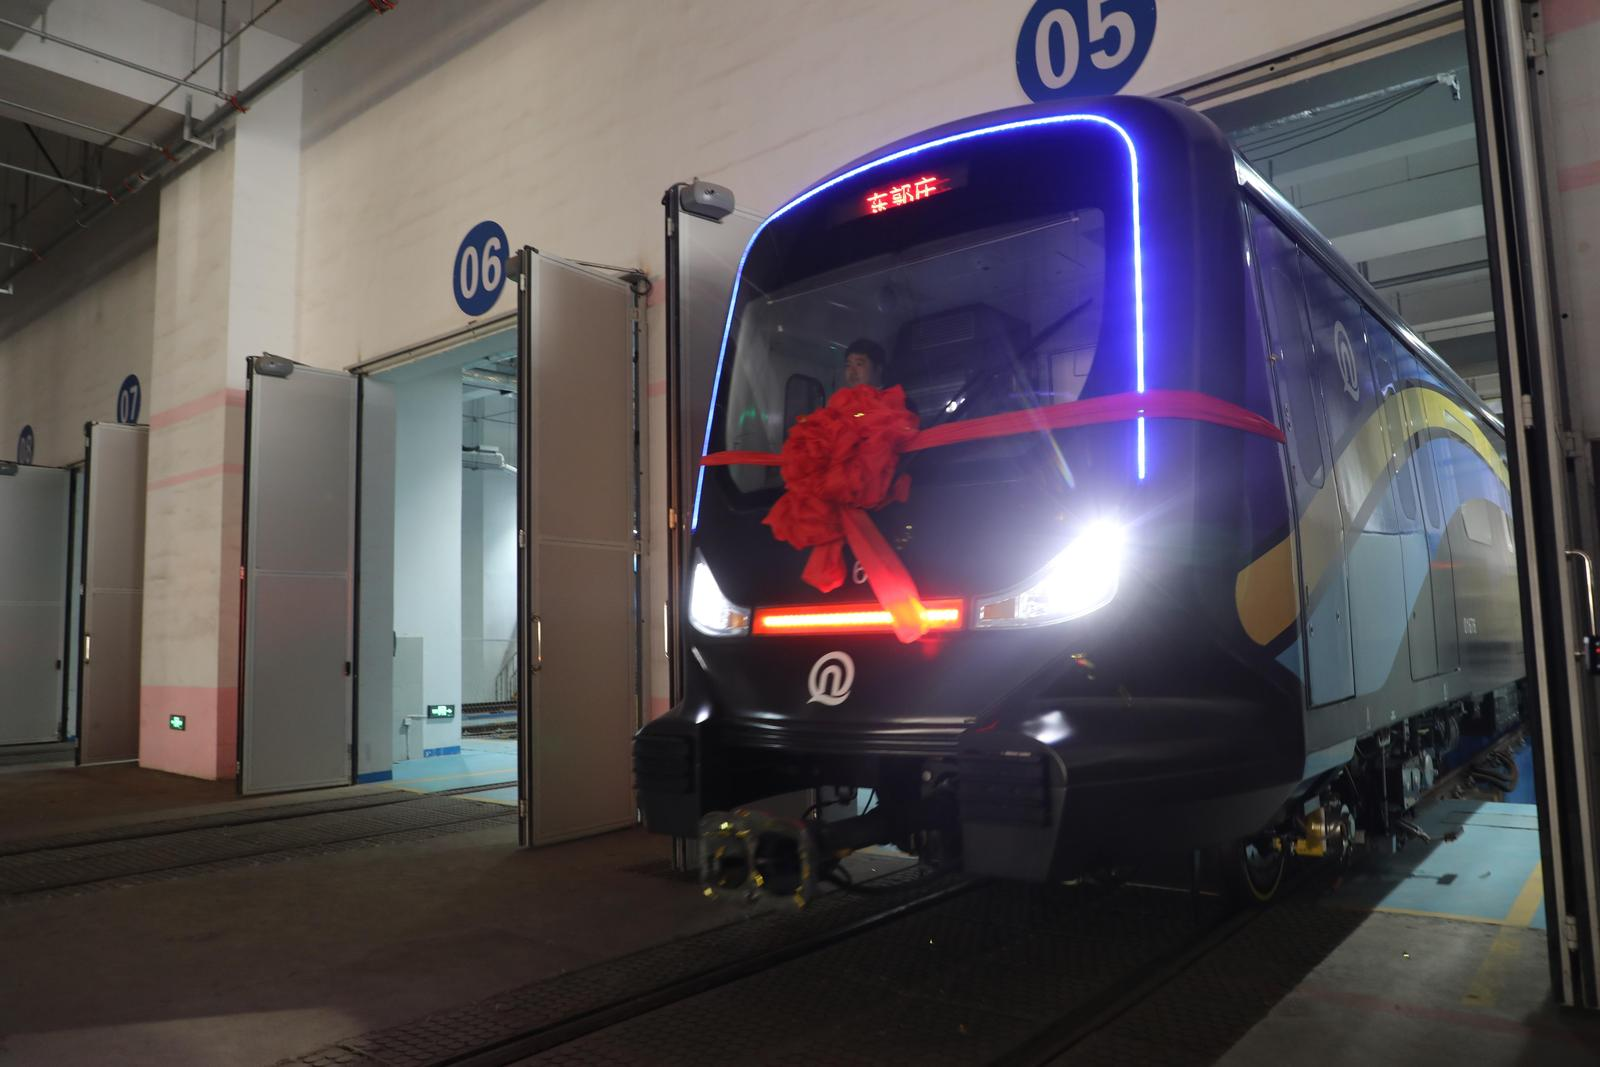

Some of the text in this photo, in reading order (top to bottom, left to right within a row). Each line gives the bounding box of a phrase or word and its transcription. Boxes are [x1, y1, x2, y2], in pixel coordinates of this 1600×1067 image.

[1035, 0, 1136, 90] 05
[460, 236, 502, 299] 06
[120, 385, 138, 423] 07
